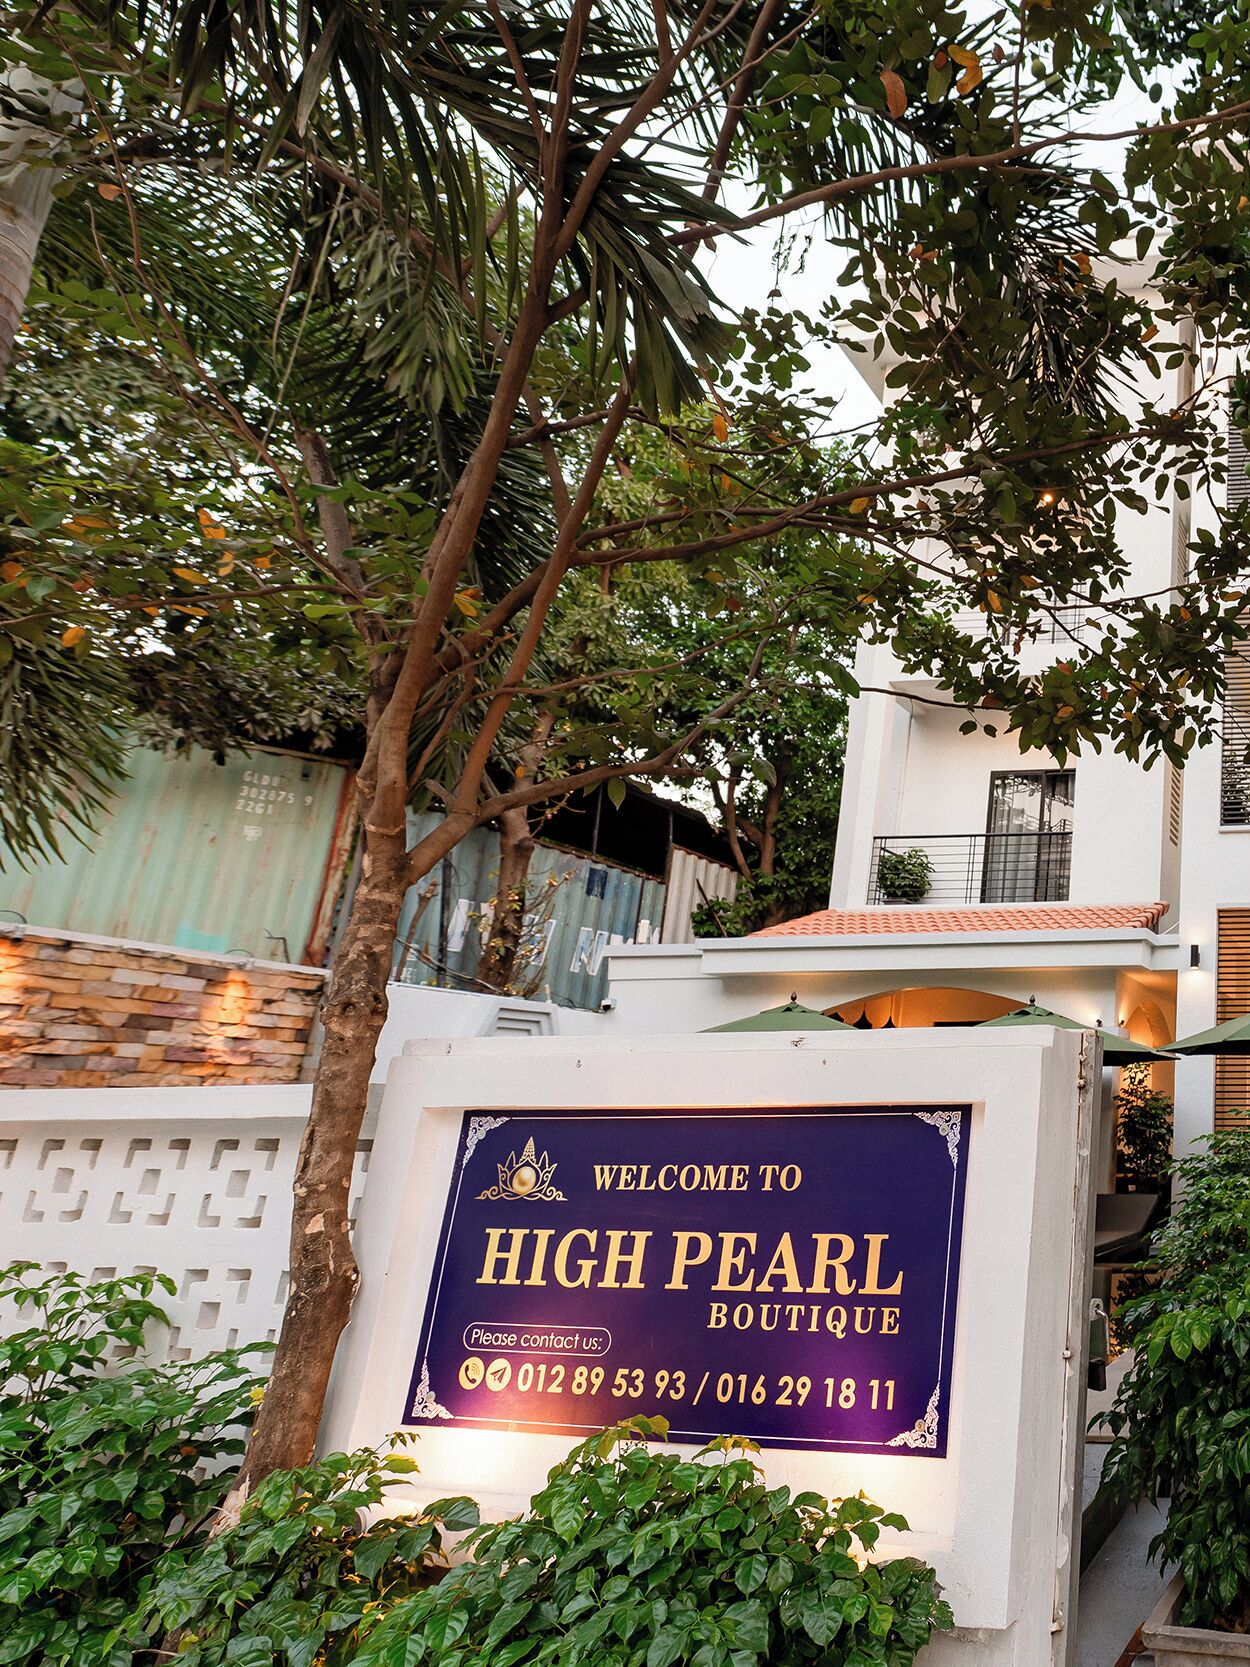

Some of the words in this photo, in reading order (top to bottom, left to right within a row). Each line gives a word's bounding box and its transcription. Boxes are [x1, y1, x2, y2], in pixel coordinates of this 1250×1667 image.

[593, 1164, 750, 1192] WELCOME
[758, 1164, 802, 1192] TO
[475, 1227, 653, 1289] HIGH
[664, 1231, 904, 1296] PEARL
[470, 1328, 518, 1347] Please
[520, 1332, 580, 1349] contact
[582, 1336, 603, 1350] us:
[706, 1302, 901, 1340] BOUTIQUE
[517, 1362, 566, 1394] 012
[571, 1365, 605, 1396] 89
[611, 1367, 645, 1398] 53
[655, 1369, 686, 1400] 93
[716, 1372, 766, 1405] 016
[775, 1375, 812, 1407] 29
[823, 1377, 856, 1409] 18
[868, 1379, 895, 1411] 11
